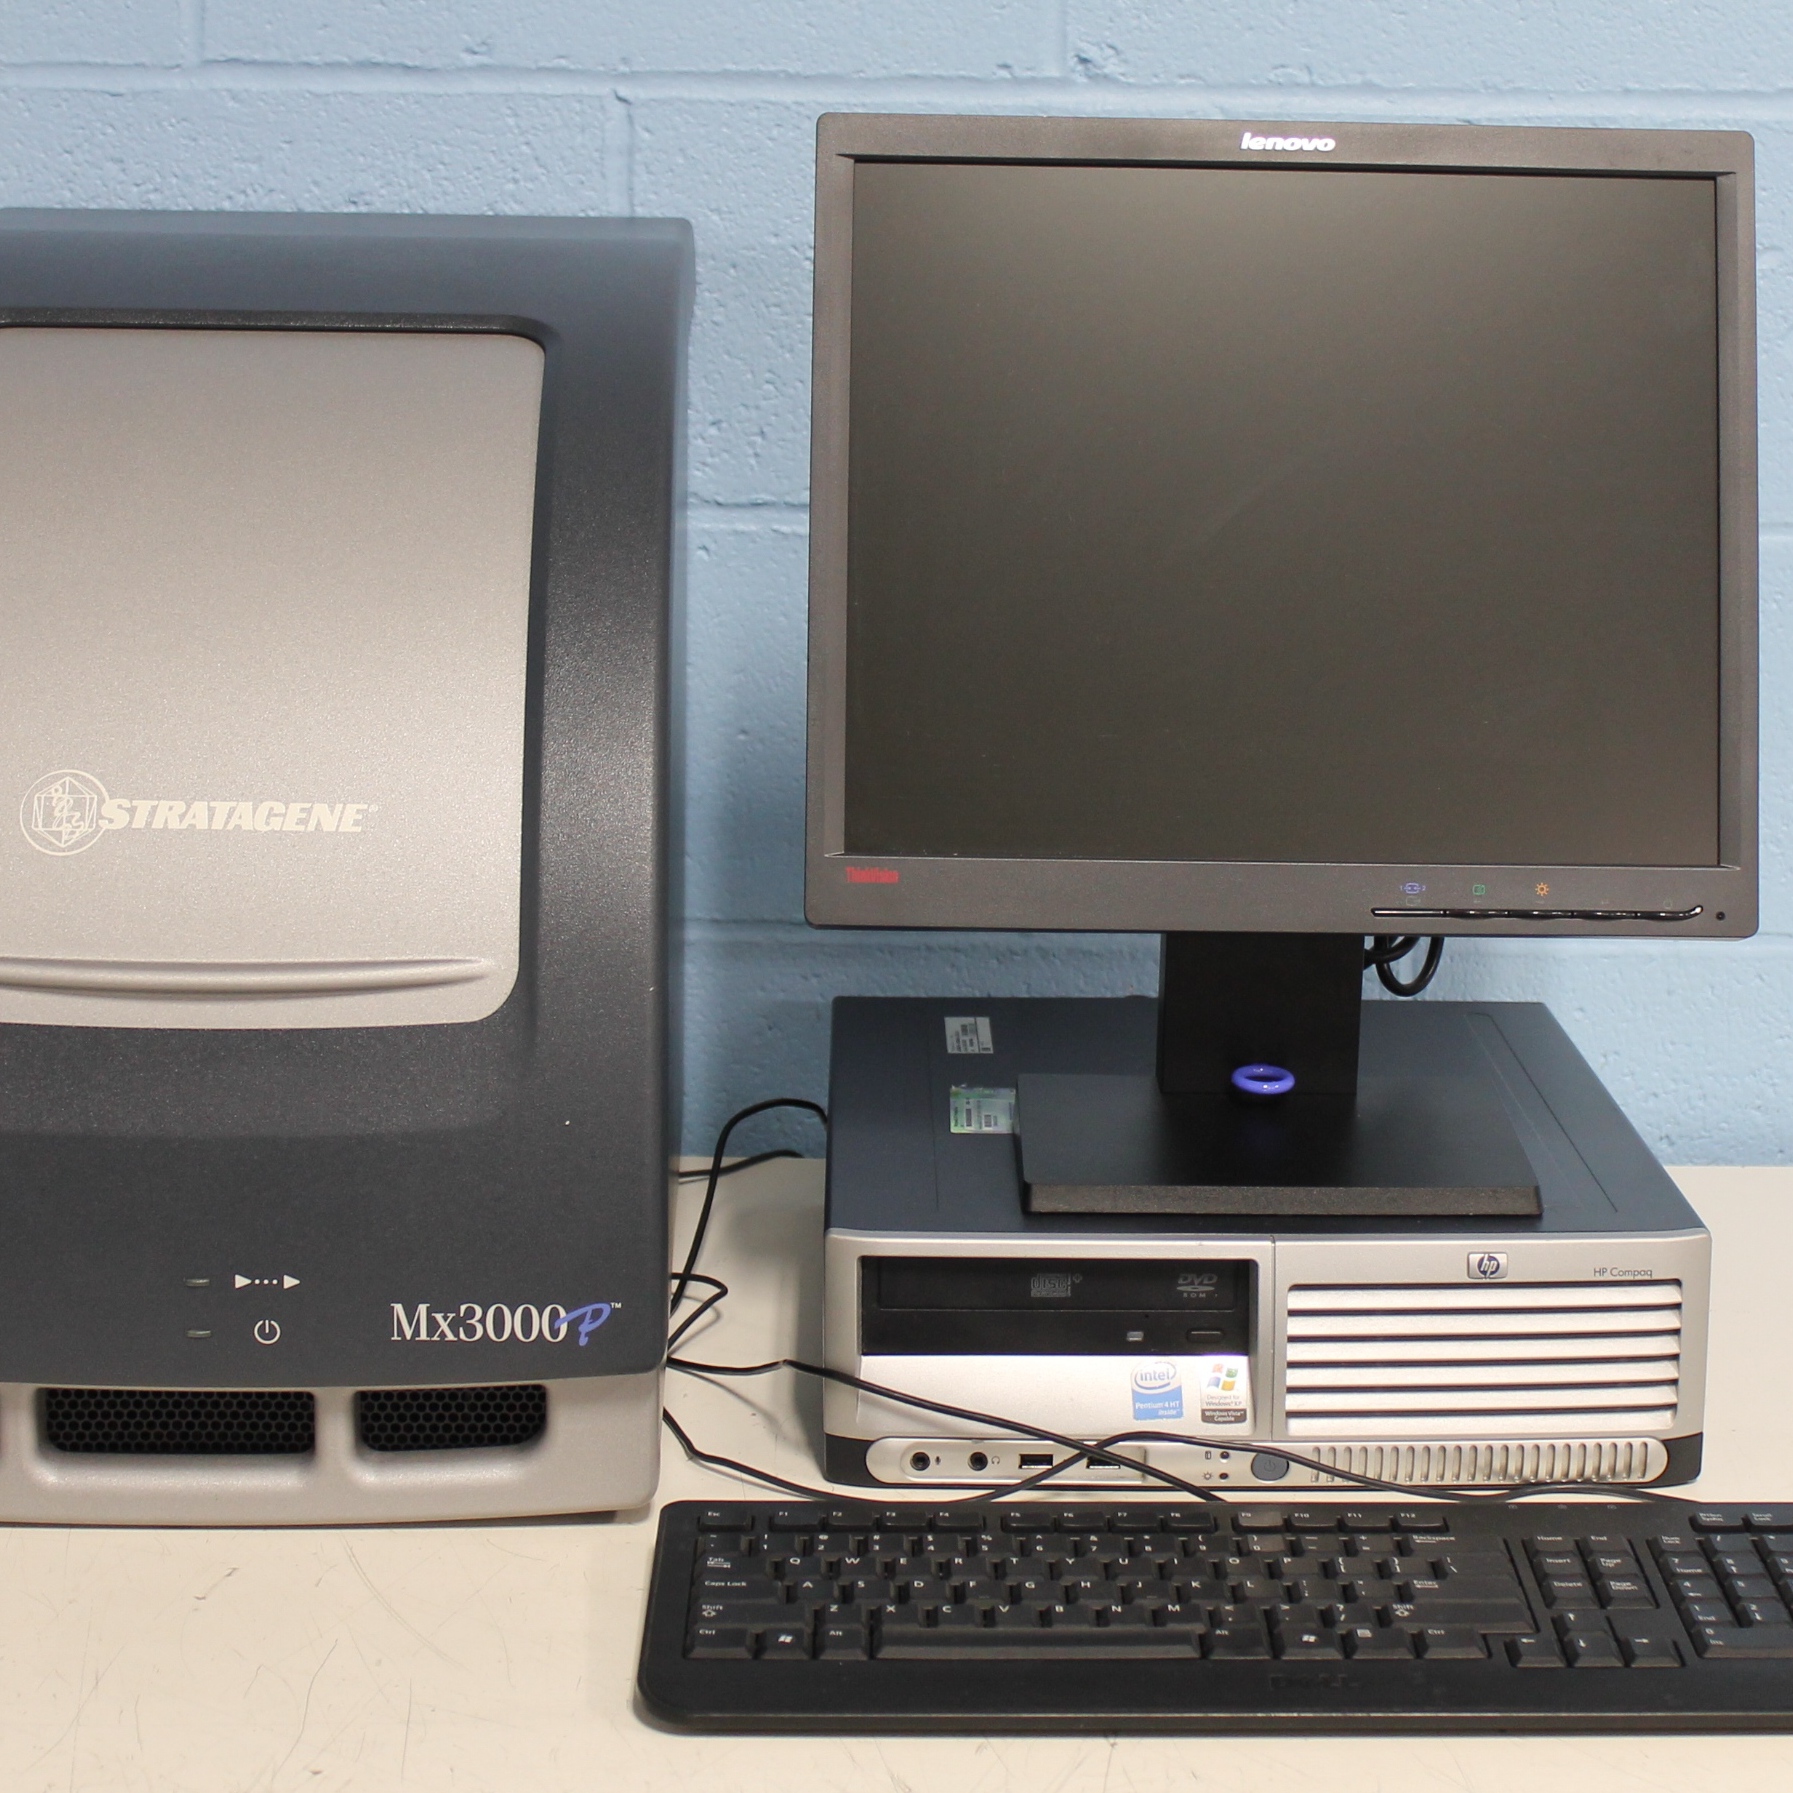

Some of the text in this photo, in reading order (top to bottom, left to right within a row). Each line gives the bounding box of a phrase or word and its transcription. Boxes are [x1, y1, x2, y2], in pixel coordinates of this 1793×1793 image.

[1240, 132, 1336, 151] lenovo
[1477, 1254, 1499, 1279] hp
[1593, 1267, 1653, 1279] HP Compaq
[1178, 1273, 1218, 1286] DVD
[1140, 1368, 1170, 1381] intel
[1206, 1394, 1231, 1402] Designed
[1135, 1402, 1163, 1410] Pentium
[789, 1557, 801, 1565] Q
[899, 1557, 907, 1565] E
[954, 1557, 963, 1565] R
[1010, 1557, 1019, 1565] T
[1228, 1557, 1240, 1565] O
[1025, 1581, 1036, 1589] G
[1246, 1580, 1255, 1588] L
[829, 1604, 838, 1612] Z
[886, 1605, 896, 1613] X
[942, 1605, 952, 1613] C
[998, 1605, 1010, 1613] V
[1055, 1605, 1064, 1613] B
[1111, 1605, 1122, 1613] N
[1167, 1604, 1181, 1612] M
